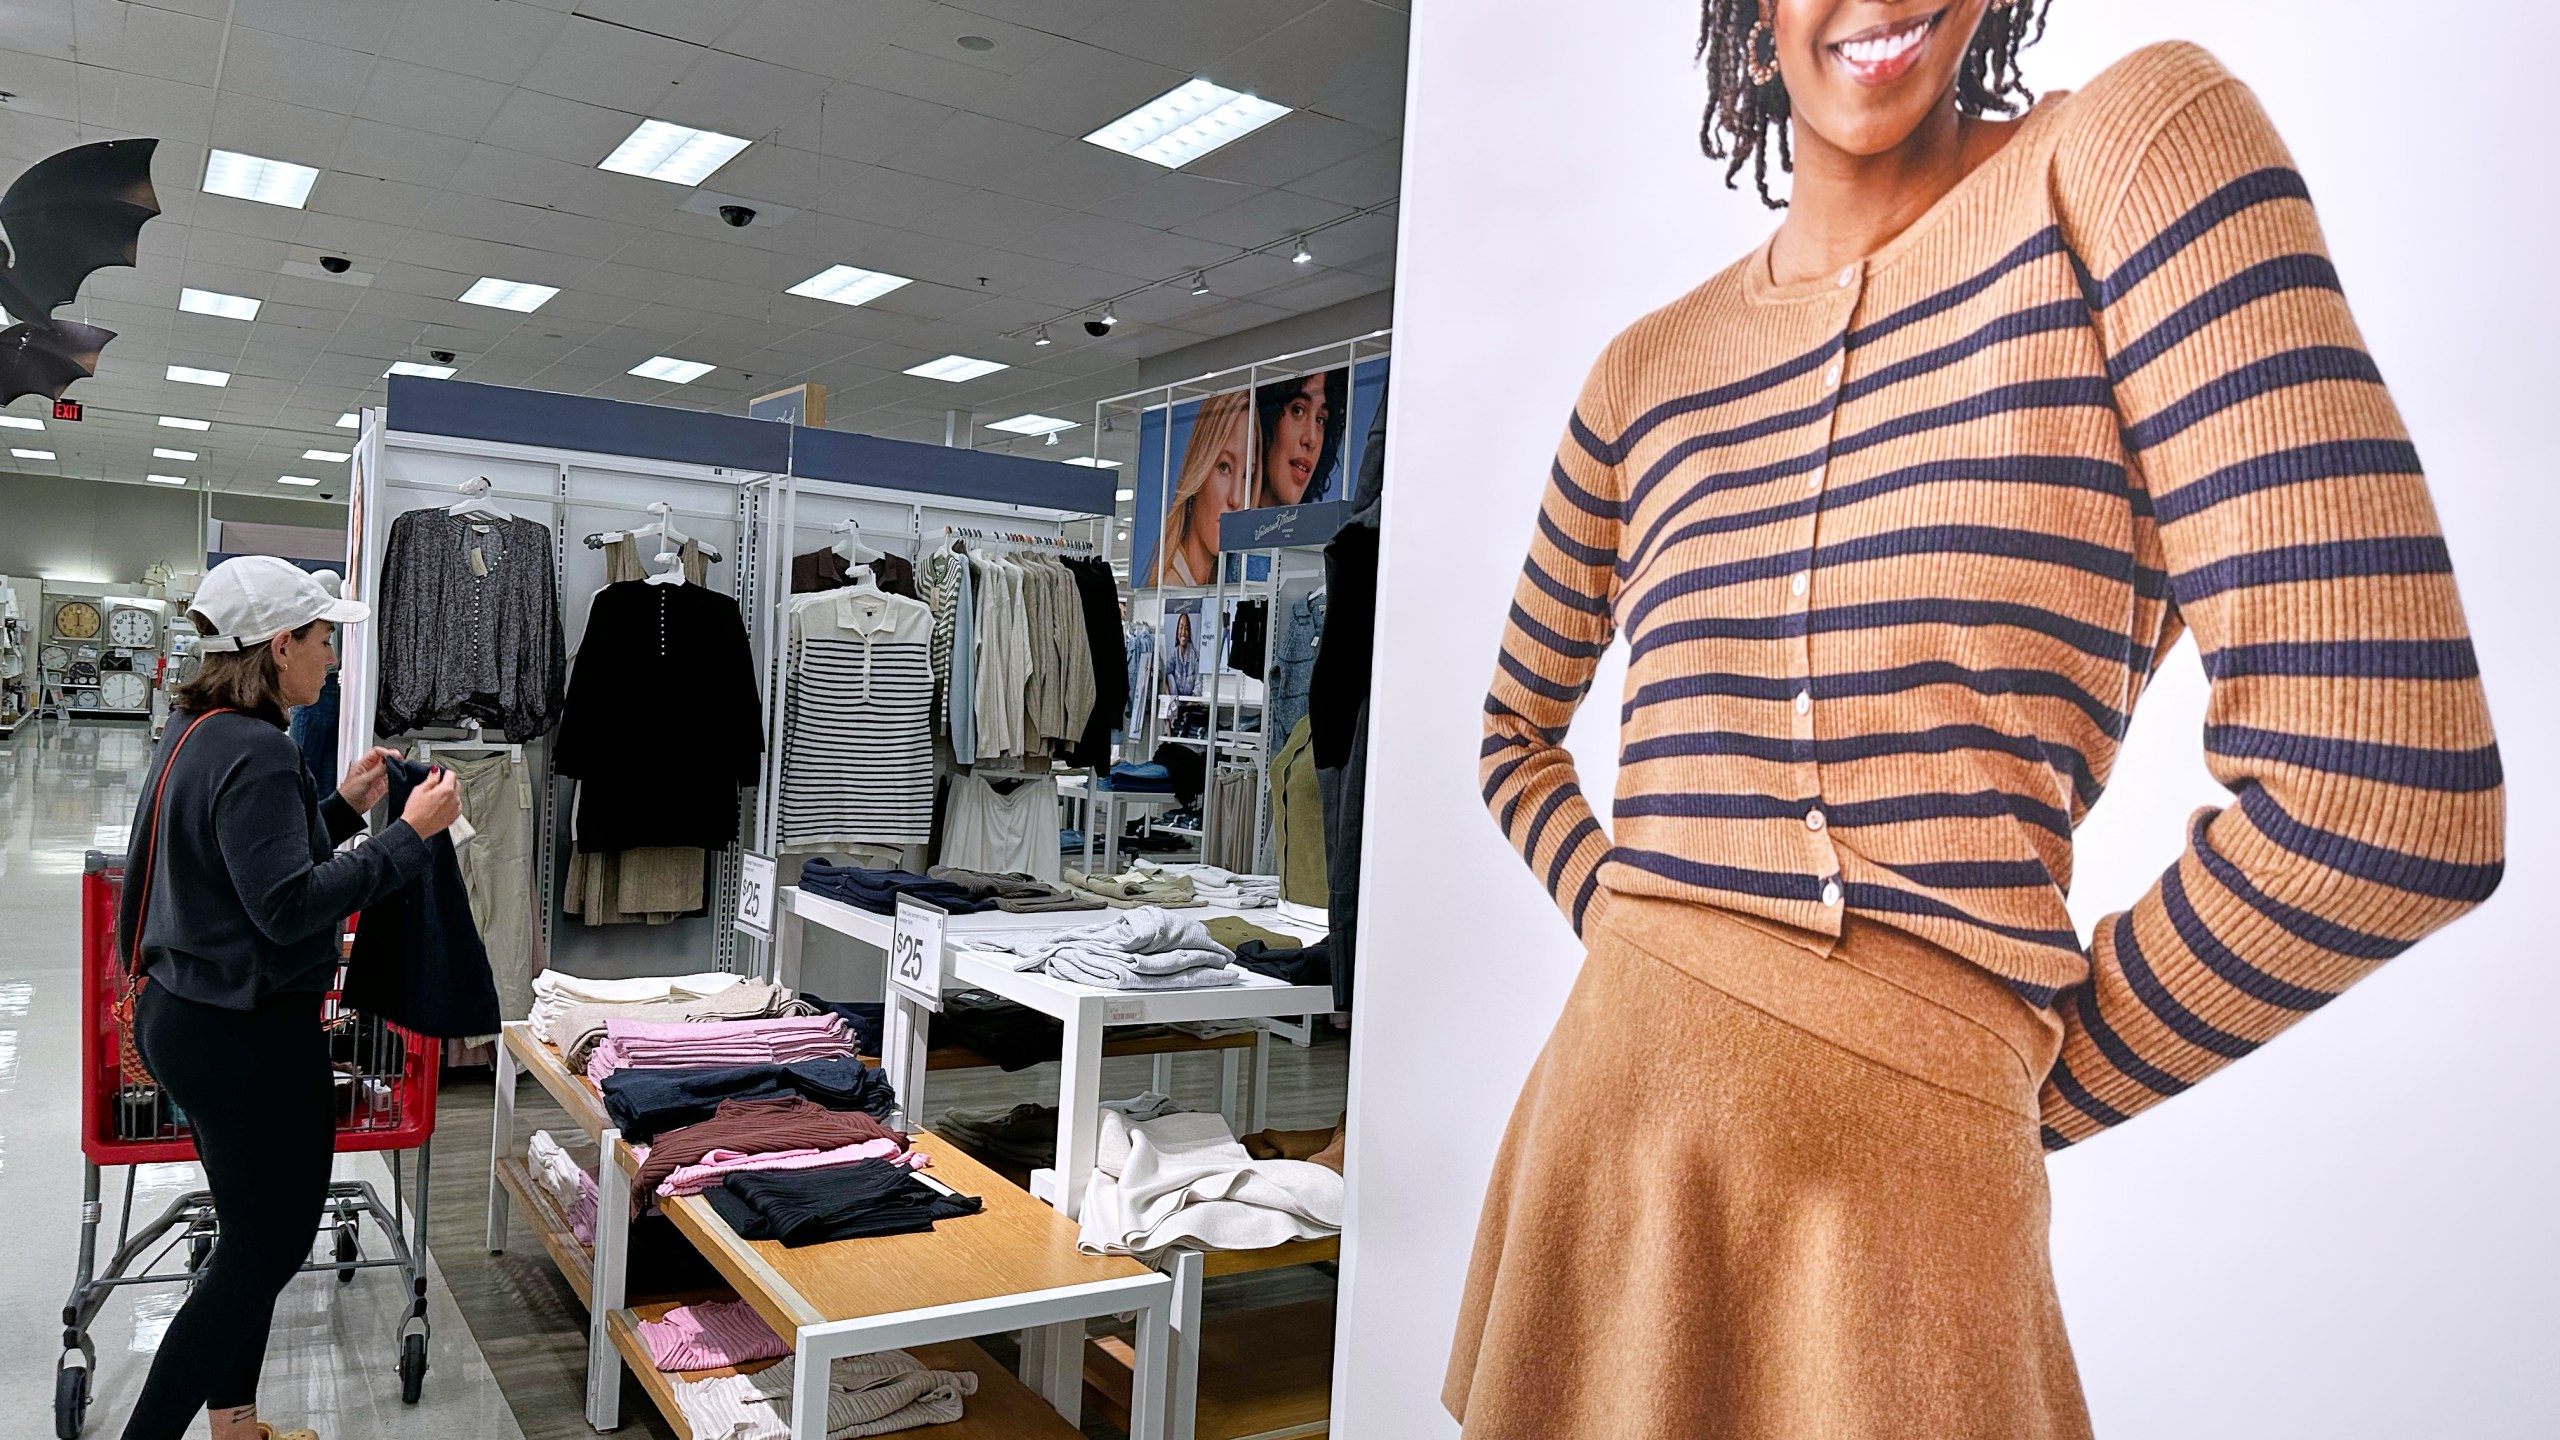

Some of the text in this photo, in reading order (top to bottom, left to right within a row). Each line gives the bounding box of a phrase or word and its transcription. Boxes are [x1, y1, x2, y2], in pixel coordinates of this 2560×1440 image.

[56, 404, 79, 419] EXIT
[742, 879, 760, 917] $25
[897, 932, 923, 981] $25
